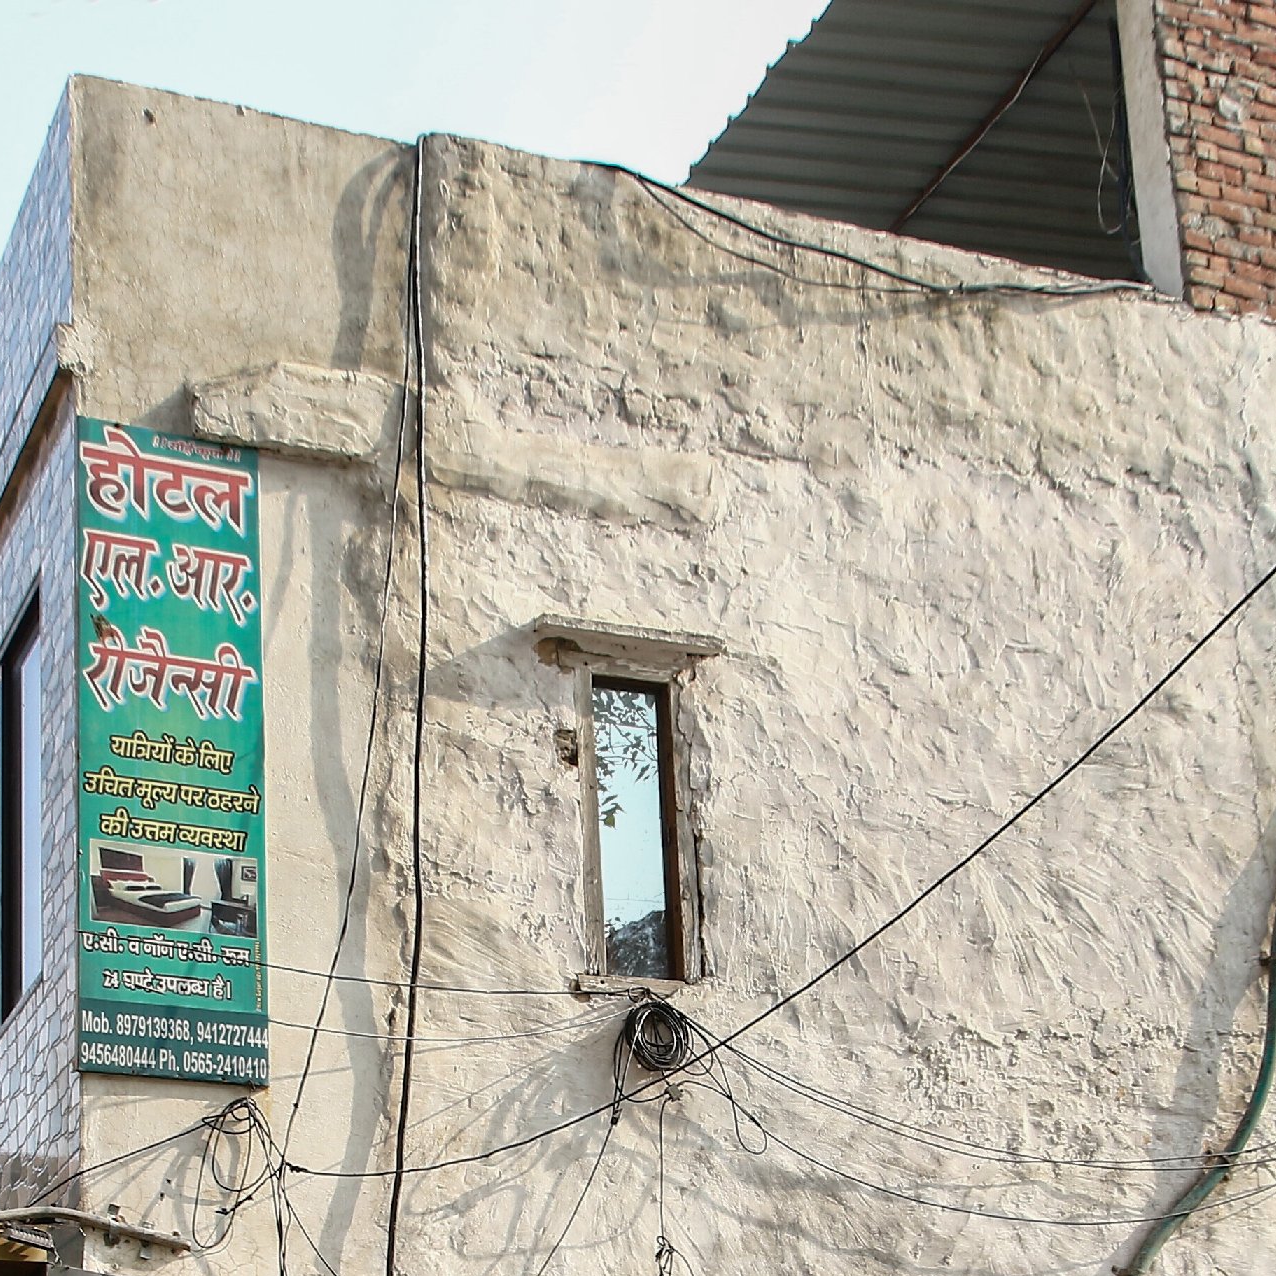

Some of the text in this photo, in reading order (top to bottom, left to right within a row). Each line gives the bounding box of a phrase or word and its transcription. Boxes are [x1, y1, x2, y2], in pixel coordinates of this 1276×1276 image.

[81, 426, 251, 536] होटल
[83, 624, 259, 721] रीजैन्सी
[109, 729, 234, 775] यात्रियों के लिए
[83, 765, 261, 815] उचित मूल्य पर ठहरने
[99, 806, 247, 852] की उत्तम व्यवस्था
[82, 927, 124, 953] ए.सी.
[128, 936, 140, 955] व
[142, 933, 174, 959] नॉन
[154, 975, 210, 997] उपलब्ध
[82, 1010, 269, 1049] Mob. 8979139368, 9412727444
[81, 1042, 267, 1079] 9456480444 Ph. 0565-2410410
